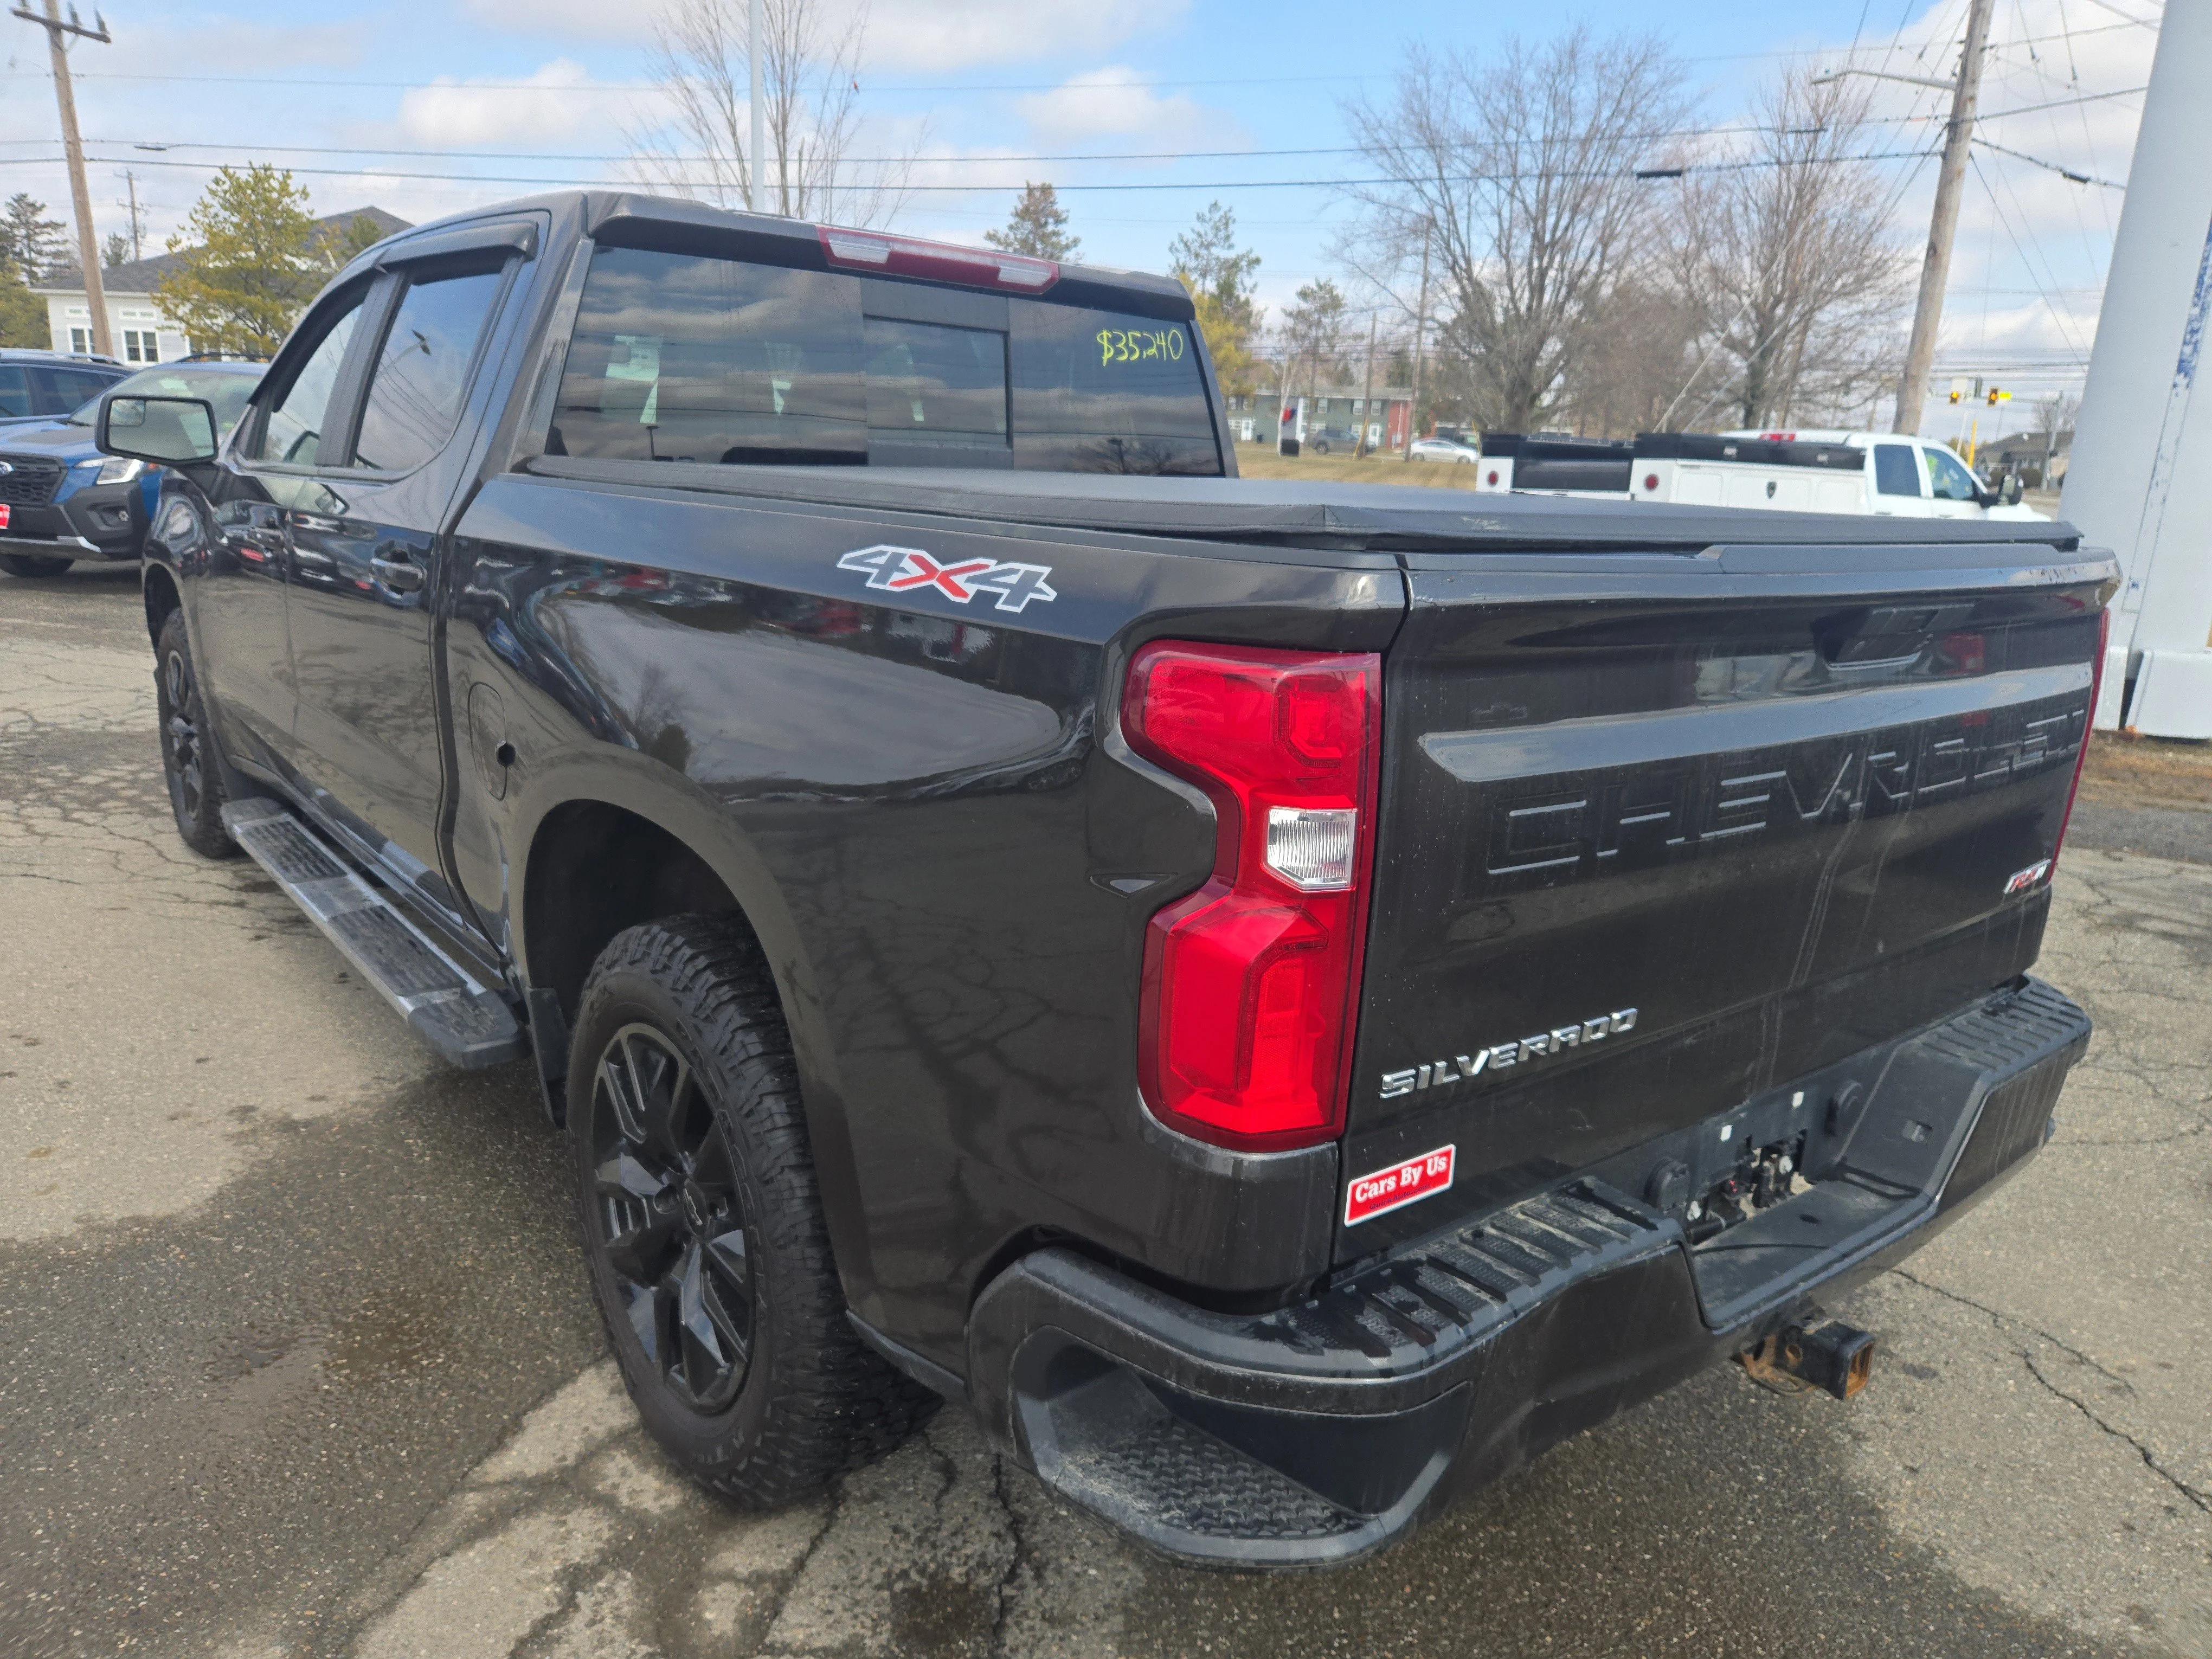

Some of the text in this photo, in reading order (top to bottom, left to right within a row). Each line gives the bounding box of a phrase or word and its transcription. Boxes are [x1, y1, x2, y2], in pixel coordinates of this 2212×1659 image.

[1379, 1007, 1638, 1099] SILVERADO
[1355, 1155, 1448, 1203] Cars By Us
